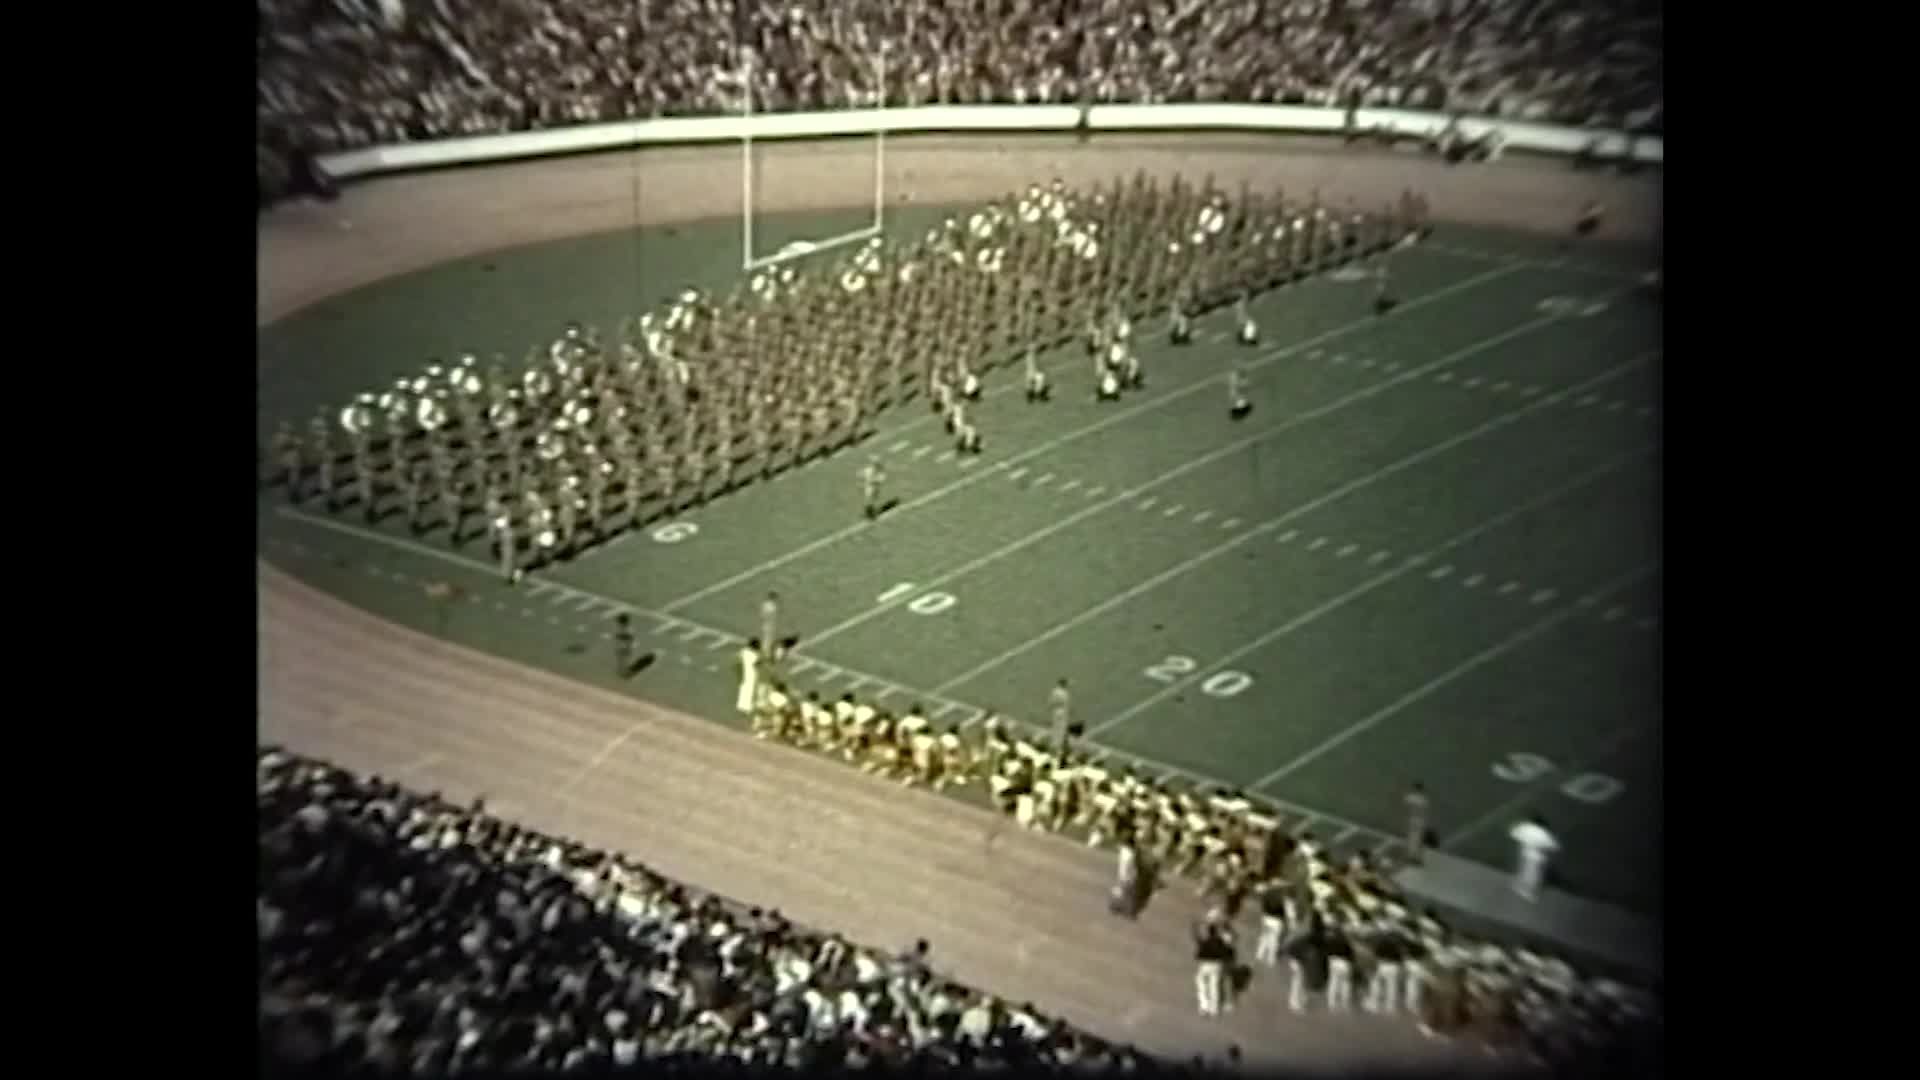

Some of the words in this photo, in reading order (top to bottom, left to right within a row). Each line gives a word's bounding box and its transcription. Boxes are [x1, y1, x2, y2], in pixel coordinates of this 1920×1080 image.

[877, 582, 956, 614] 10
[1143, 655, 1252, 697] 20
[1491, 752, 1625, 803] 30
